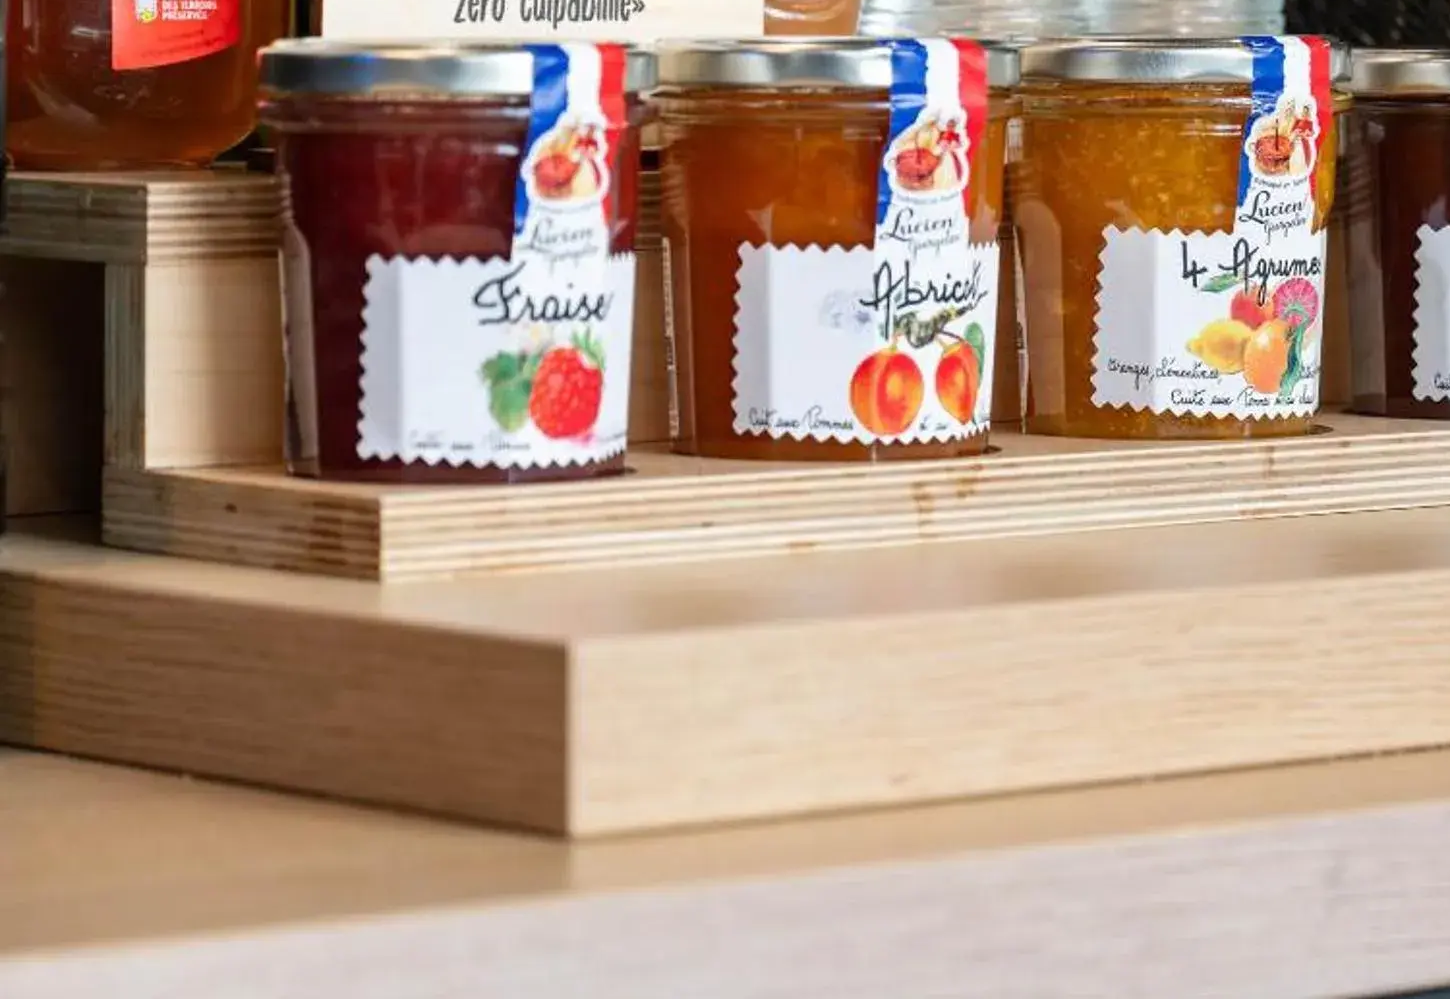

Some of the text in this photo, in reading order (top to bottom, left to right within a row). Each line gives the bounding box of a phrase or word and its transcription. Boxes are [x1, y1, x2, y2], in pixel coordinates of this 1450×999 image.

[879, 207, 953, 242] Lucien
[1239, 190, 1303, 224] Lucien
[1180, 240, 1208, 288] 4
[473, 261, 614, 326] Fraise
